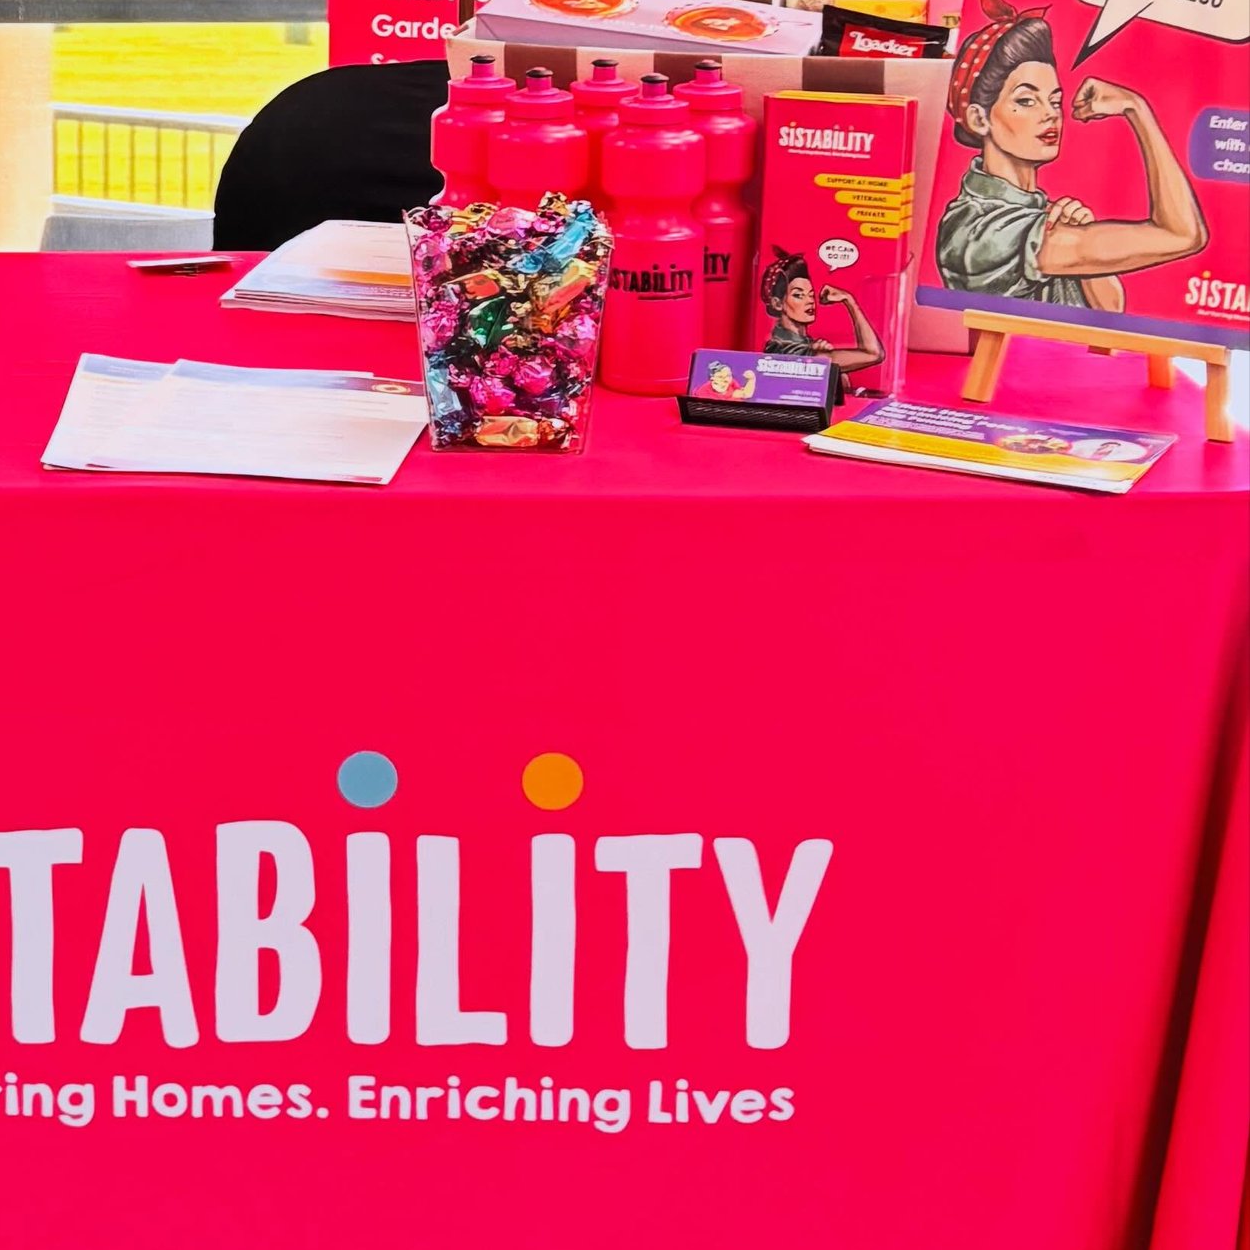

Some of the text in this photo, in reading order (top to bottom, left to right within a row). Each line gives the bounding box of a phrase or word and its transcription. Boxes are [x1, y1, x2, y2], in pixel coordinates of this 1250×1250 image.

[372, 14, 457, 40] Garde
[850, 31, 918, 56] Loacker
[1210, 115, 1248, 131] Enter
[113, 1076, 328, 1118] Homes.
[349, 1076, 630, 1133] Enriching
[649, 1079, 794, 1123] Lives
